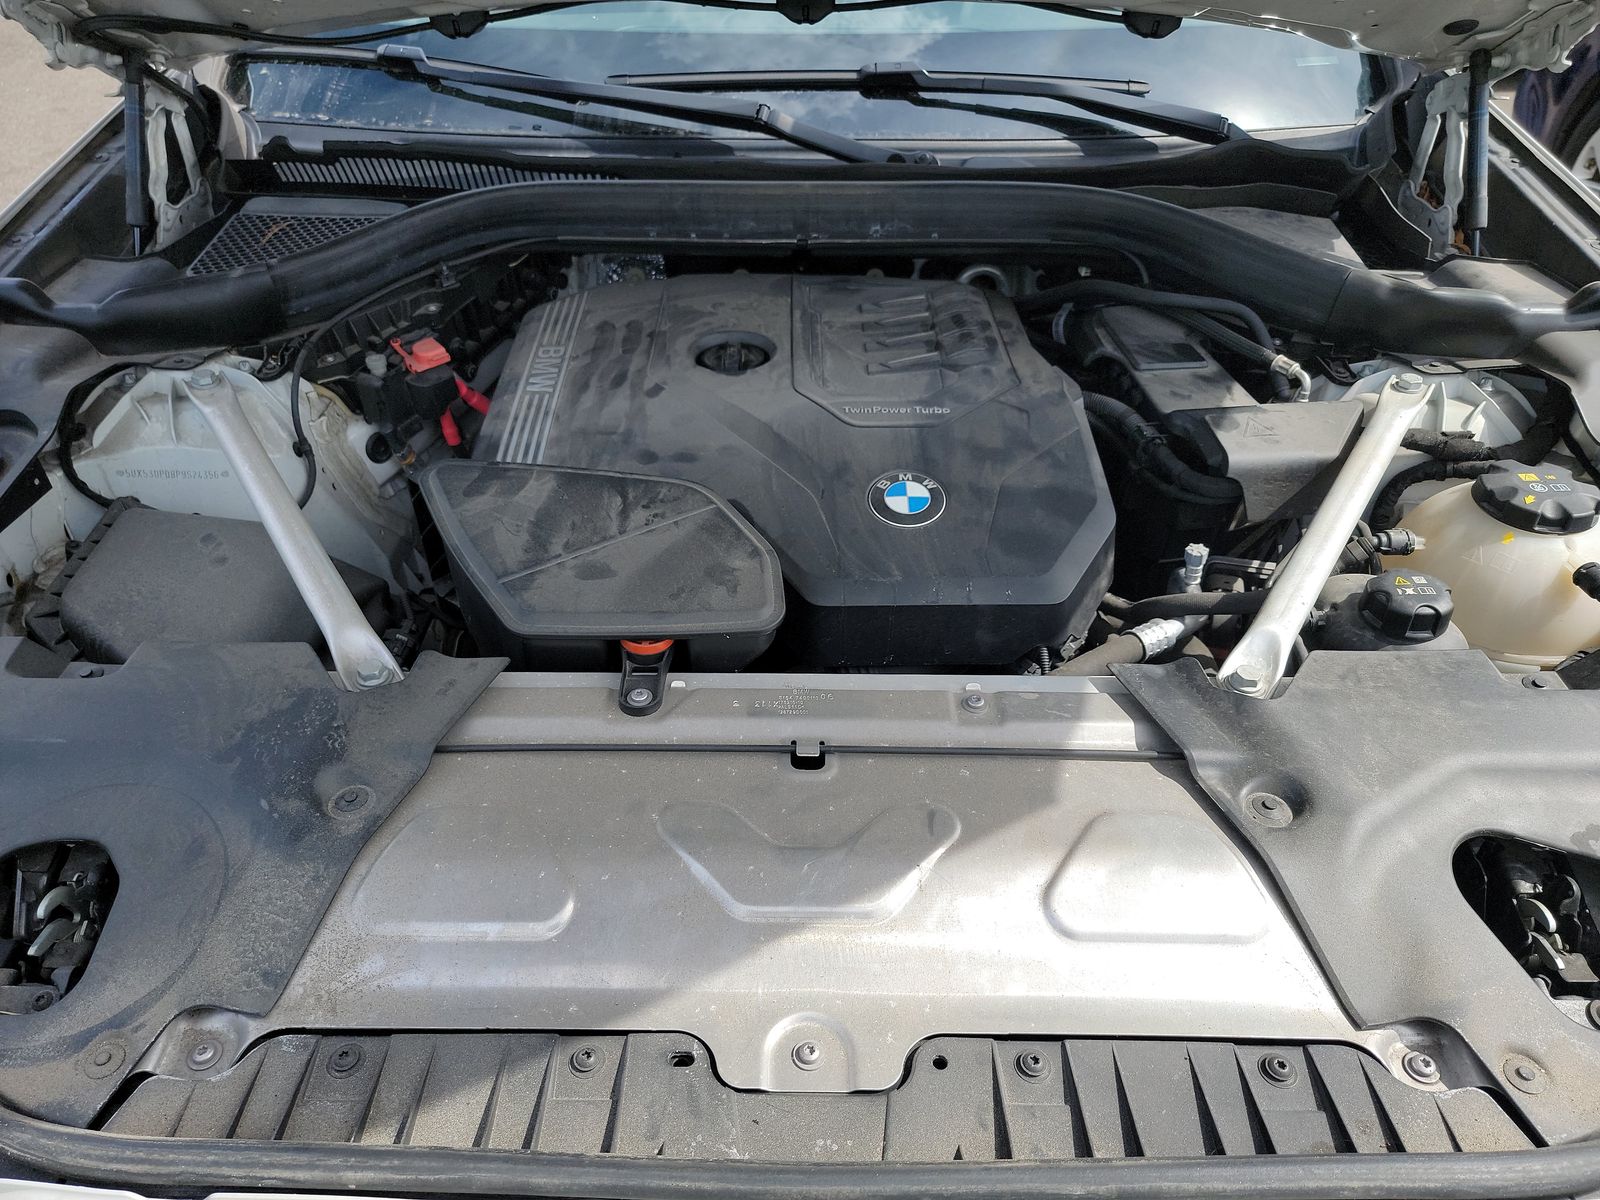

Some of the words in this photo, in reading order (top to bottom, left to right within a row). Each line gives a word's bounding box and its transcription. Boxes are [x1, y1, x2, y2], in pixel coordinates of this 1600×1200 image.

[526, 346, 565, 392] BMW
[842, 406, 912, 414] TwinPower
[913, 406, 951, 414] Turbo
[877, 472, 937, 490] BMW
